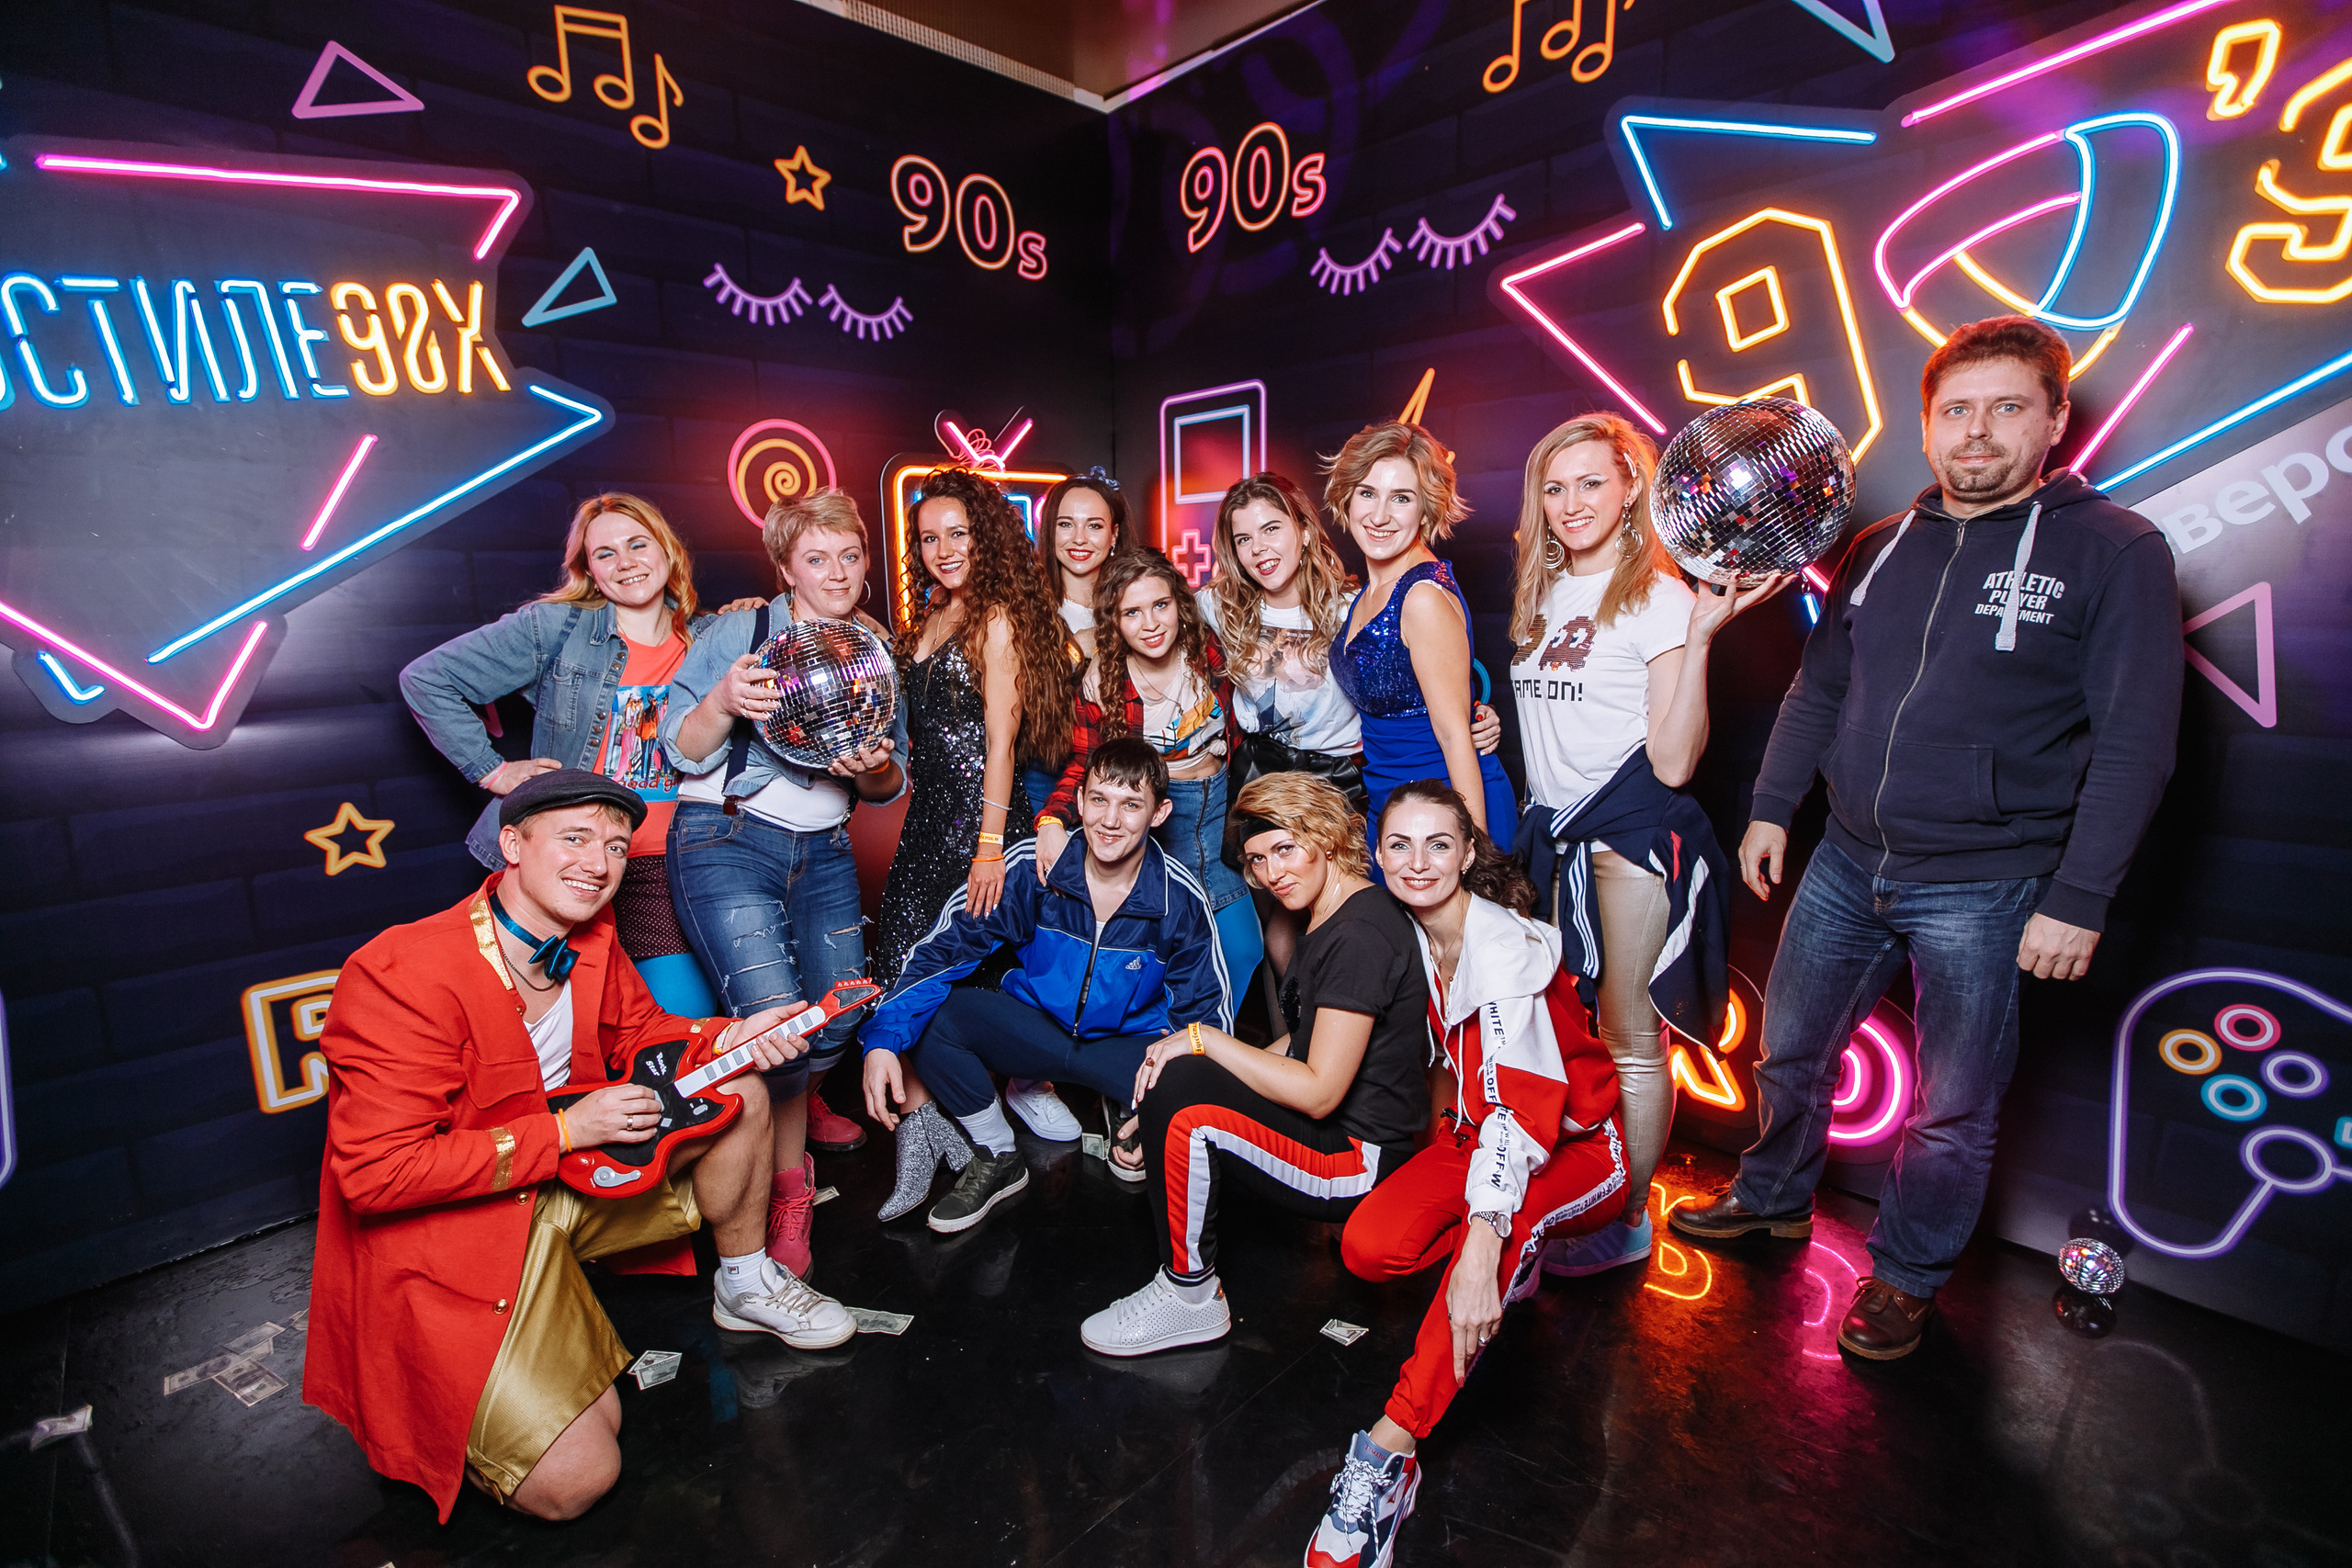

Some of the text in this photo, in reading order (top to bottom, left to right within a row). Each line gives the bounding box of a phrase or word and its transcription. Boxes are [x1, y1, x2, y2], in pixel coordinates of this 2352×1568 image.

[1181, 122, 1326, 253] 90s
[890, 154, 1047, 280] 90s
[2163, 425, 2352, 555] вер
[1982, 570, 2065, 599] ATHLETIC
[1988, 590, 2048, 610] PLYER
[1973, 604, 2054, 625] DEPAMENT
[1513, 679, 1542, 698] AME
[645, 1060, 661, 1077] Star
[656, 1052, 667, 1076] Rock
